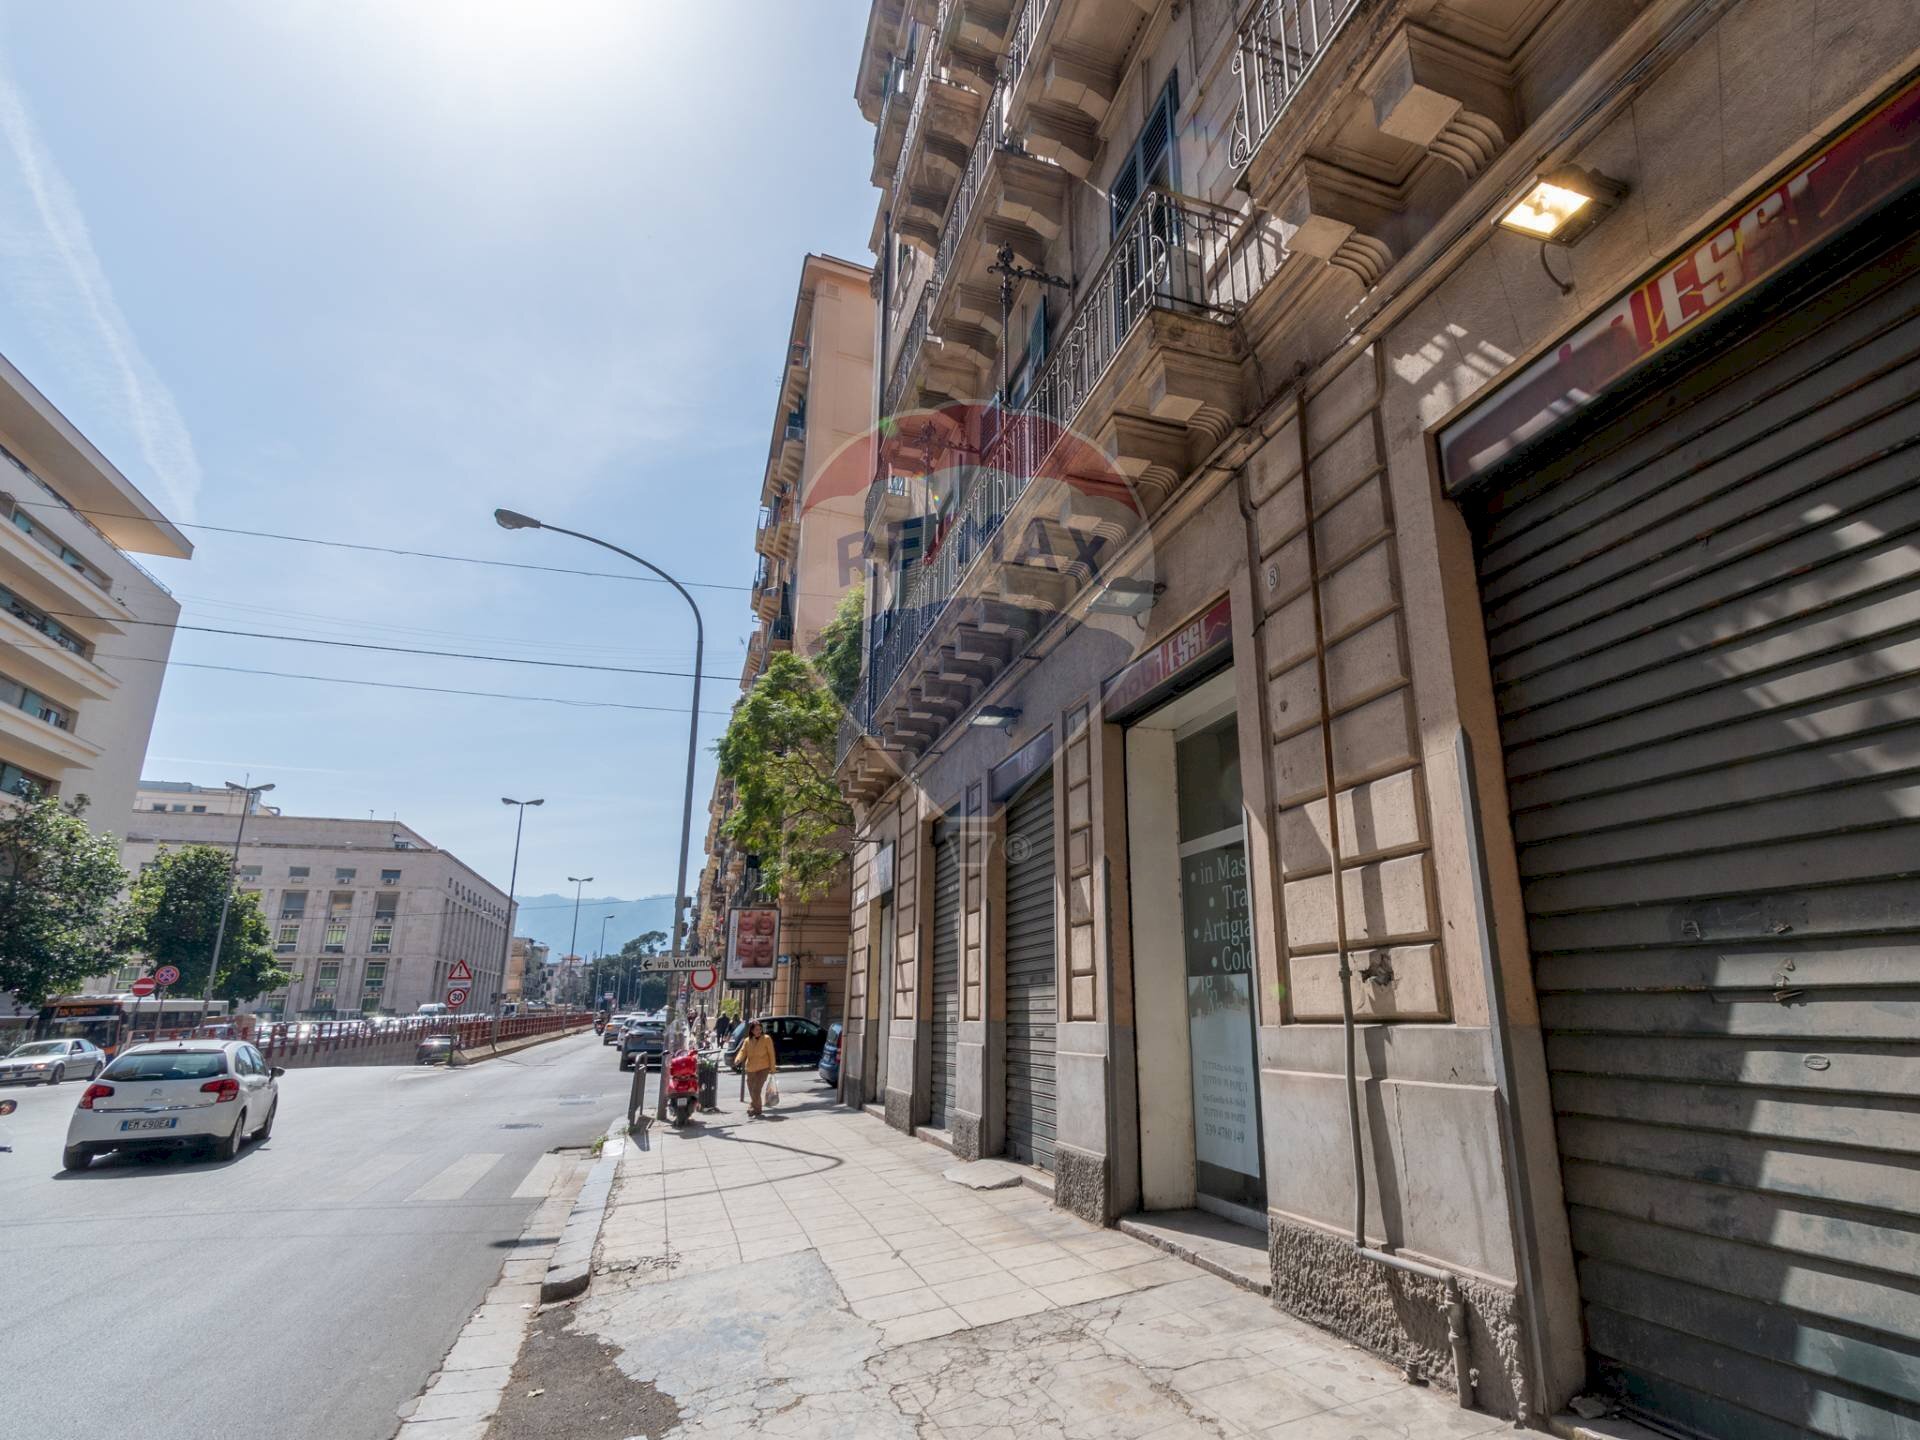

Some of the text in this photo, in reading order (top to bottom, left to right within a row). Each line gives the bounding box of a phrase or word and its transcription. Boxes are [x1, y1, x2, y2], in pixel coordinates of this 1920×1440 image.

[1200, 861, 1214, 885] in
[657, 958, 711, 969] via Volturno
[451, 992, 463, 1002] 30
